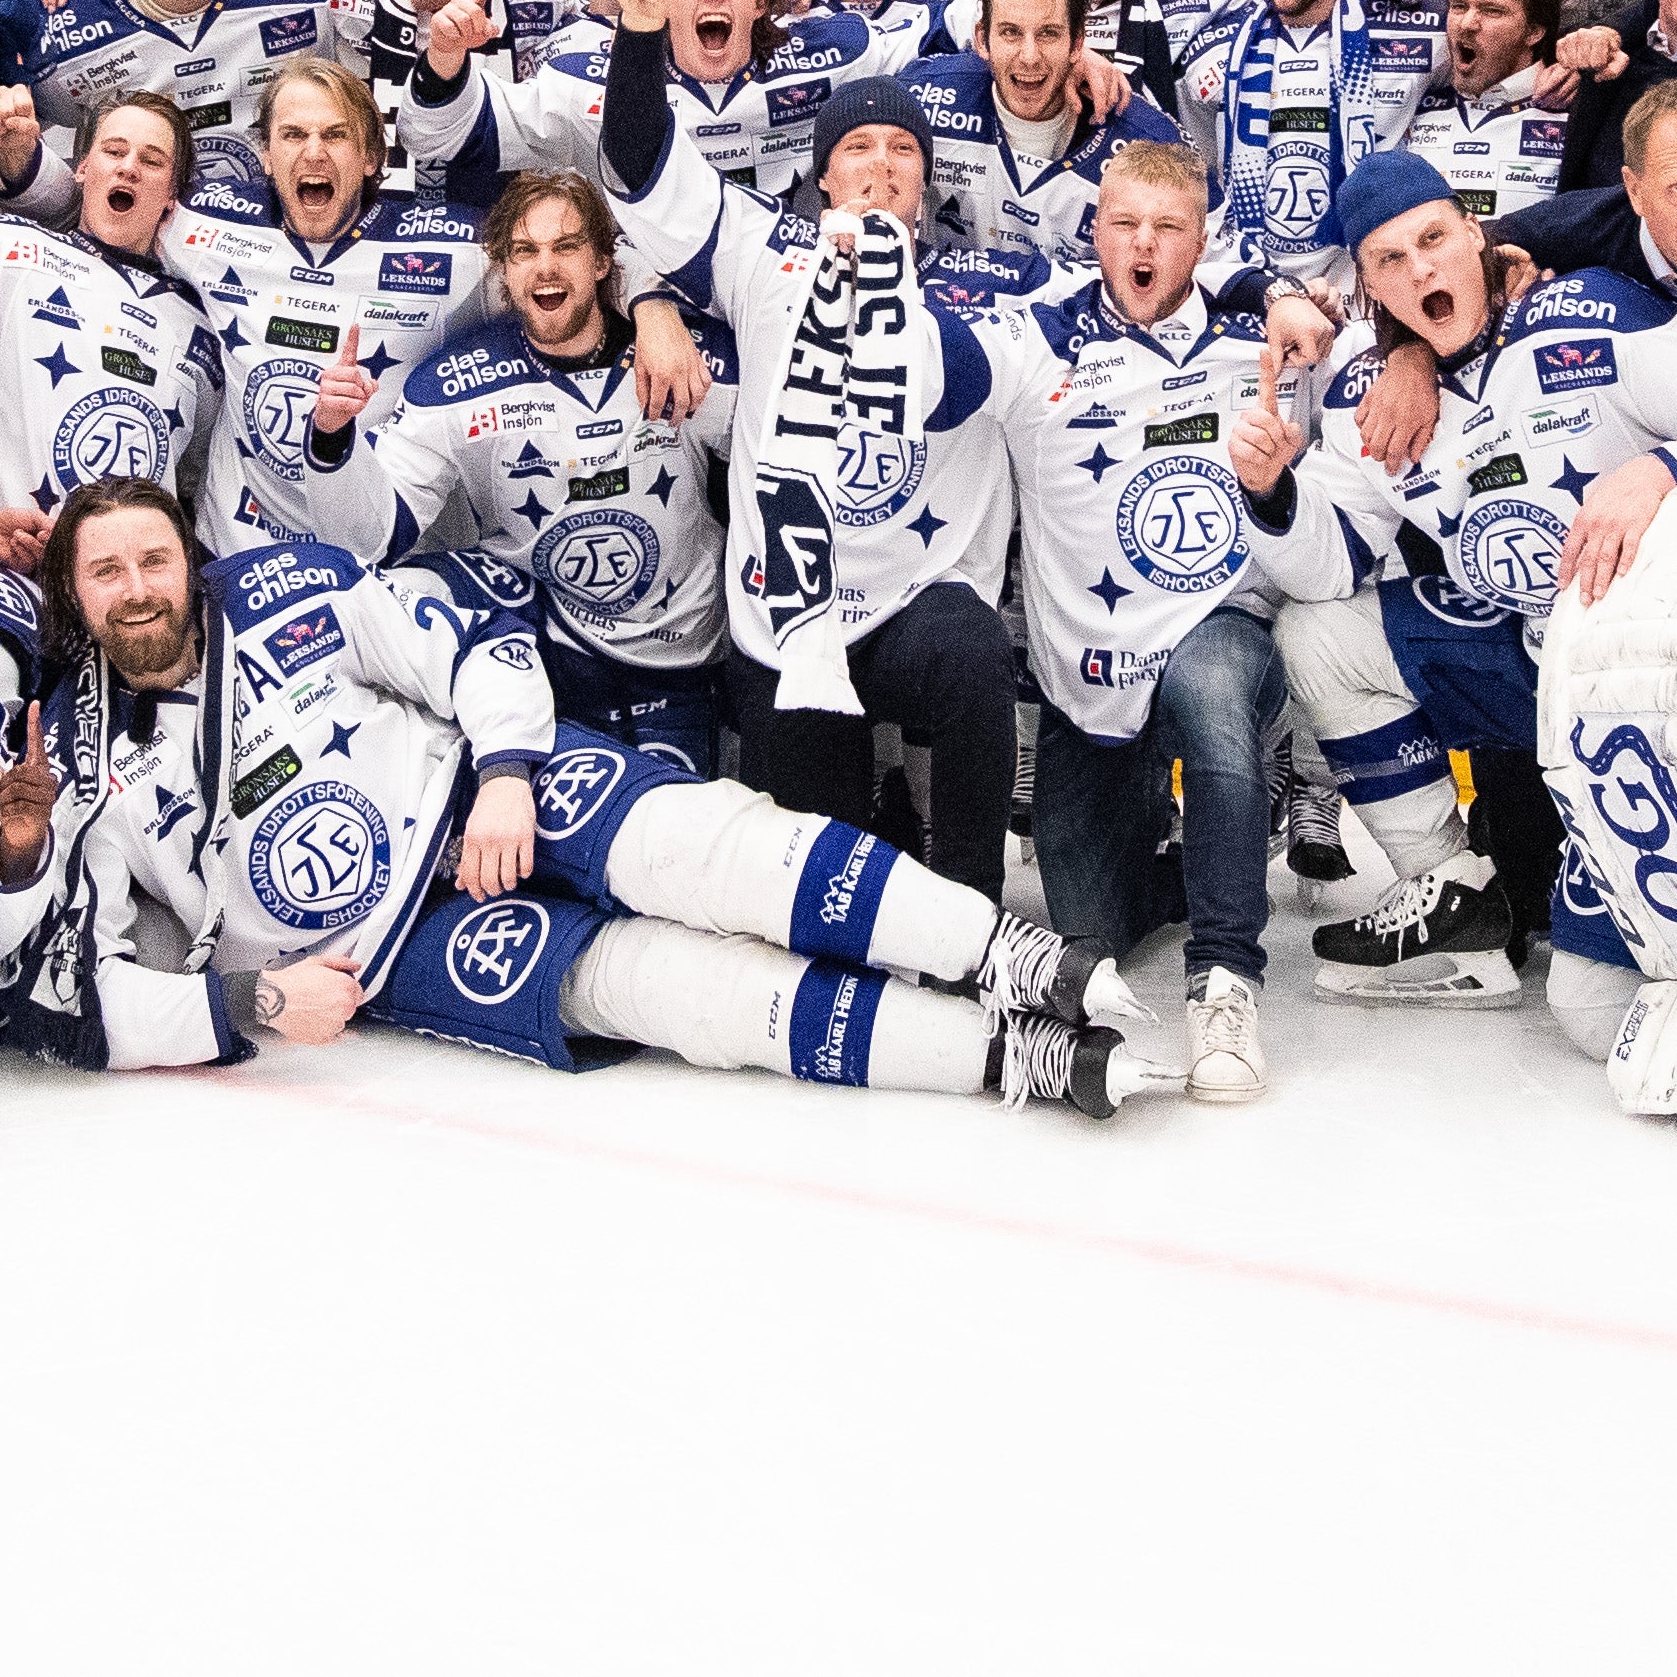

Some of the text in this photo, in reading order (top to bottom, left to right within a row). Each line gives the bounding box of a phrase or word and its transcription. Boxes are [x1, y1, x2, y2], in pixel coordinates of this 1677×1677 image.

[174, 58, 216, 77] CCM
[1279, 59, 1318, 72] CCM
[1372, 56, 1430, 69] LEKSANDS
[178, 83, 225, 98] TEGERA
[1281, 87, 1326, 97] TEGERA
[697, 123, 741, 136] CCM
[1453, 142, 1490, 156] CCM
[934, 156, 987, 175] Bergkvist
[1016, 154, 1045, 168] KLC
[933, 170, 972, 187] Insjön
[1449, 169, 1495, 180] TEGERA
[1003, 201, 1040, 225] CCM
[396, 214, 475, 240] ohlson
[290, 268, 333, 285] CCM
[939, 255, 1020, 281] ohlson
[201, 281, 259, 298] ERLANDSSON
[380, 273, 446, 288] LEKSANDS
[286, 297, 340, 312] TEGERA
[1526, 294, 1617, 326] ohlson
[121, 302, 156, 328] CCM
[363, 306, 430, 324] dalakraft
[1158, 330, 1192, 341] KLC
[436, 347, 490, 377] clas
[442, 358, 529, 395] ohlson
[574, 370, 604, 381] KLC
[1163, 374, 1207, 390] CCM
[1542, 364, 1612, 385] LEKSANDS
[500, 403, 556, 419] Bergkvist
[502, 414, 543, 430] Insjön
[577, 422, 623, 437] CCM
[1532, 408, 1591, 436] dalakraft
[55, 392, 101, 474] LEKSANDS
[239, 551, 297, 590] clas
[1147, 565, 1231, 591] ISHOCKEY
[247, 565, 338, 612] ohlson
[279, 628, 341, 669] LEKSANDS
[239, 650, 281, 705] A
[123, 754, 164, 786] Insjön
[250, 782, 388, 925] LEKSANDS IDROTTSFORENING
[326, 859, 391, 927] ISHOCKEY
[829, 1011, 848, 1054] KARL
